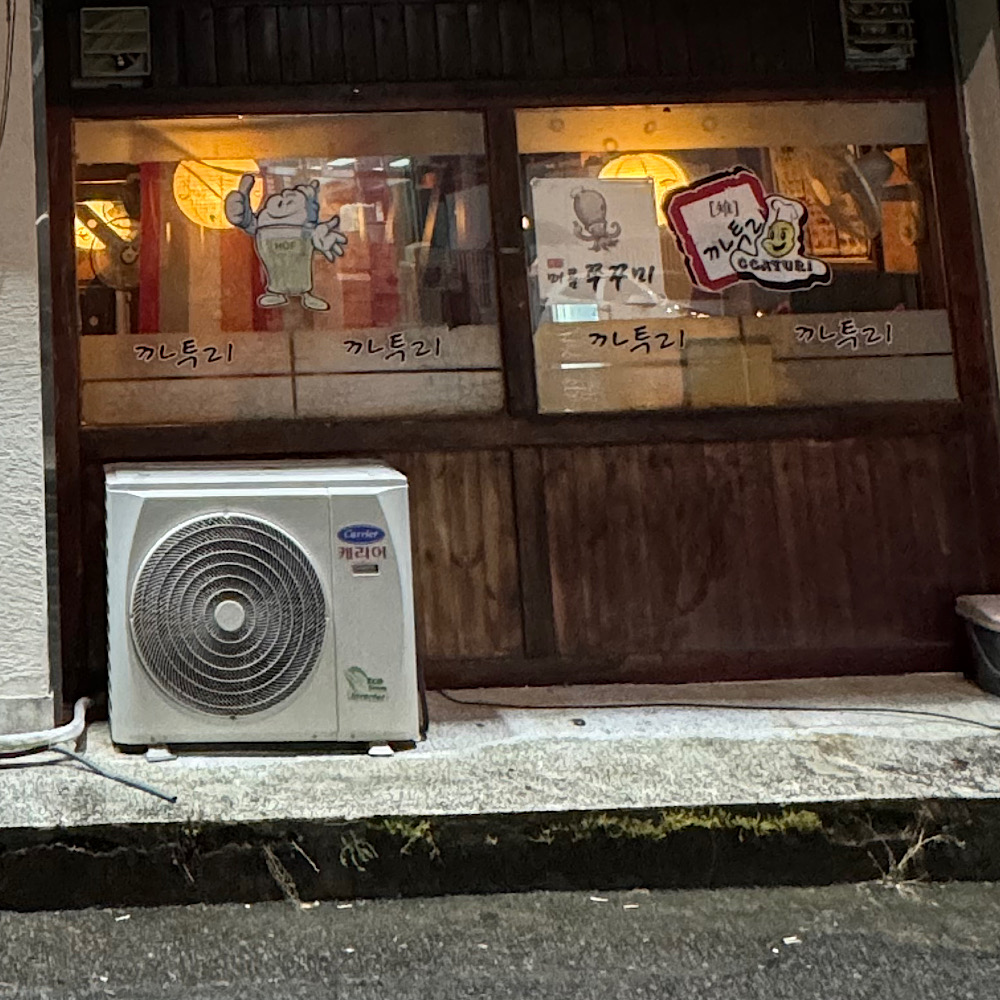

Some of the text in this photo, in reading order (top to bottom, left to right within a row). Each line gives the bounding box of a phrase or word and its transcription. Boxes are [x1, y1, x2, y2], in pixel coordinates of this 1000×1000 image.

[274, 240, 297, 250] HOF
[343, 332, 441, 362] 까투리
[589, 325, 686, 353] 까투리
[796, 319, 893, 349] 까투리
[135, 339, 234, 368] 까투리
[343, 529, 379, 539] Carrier
